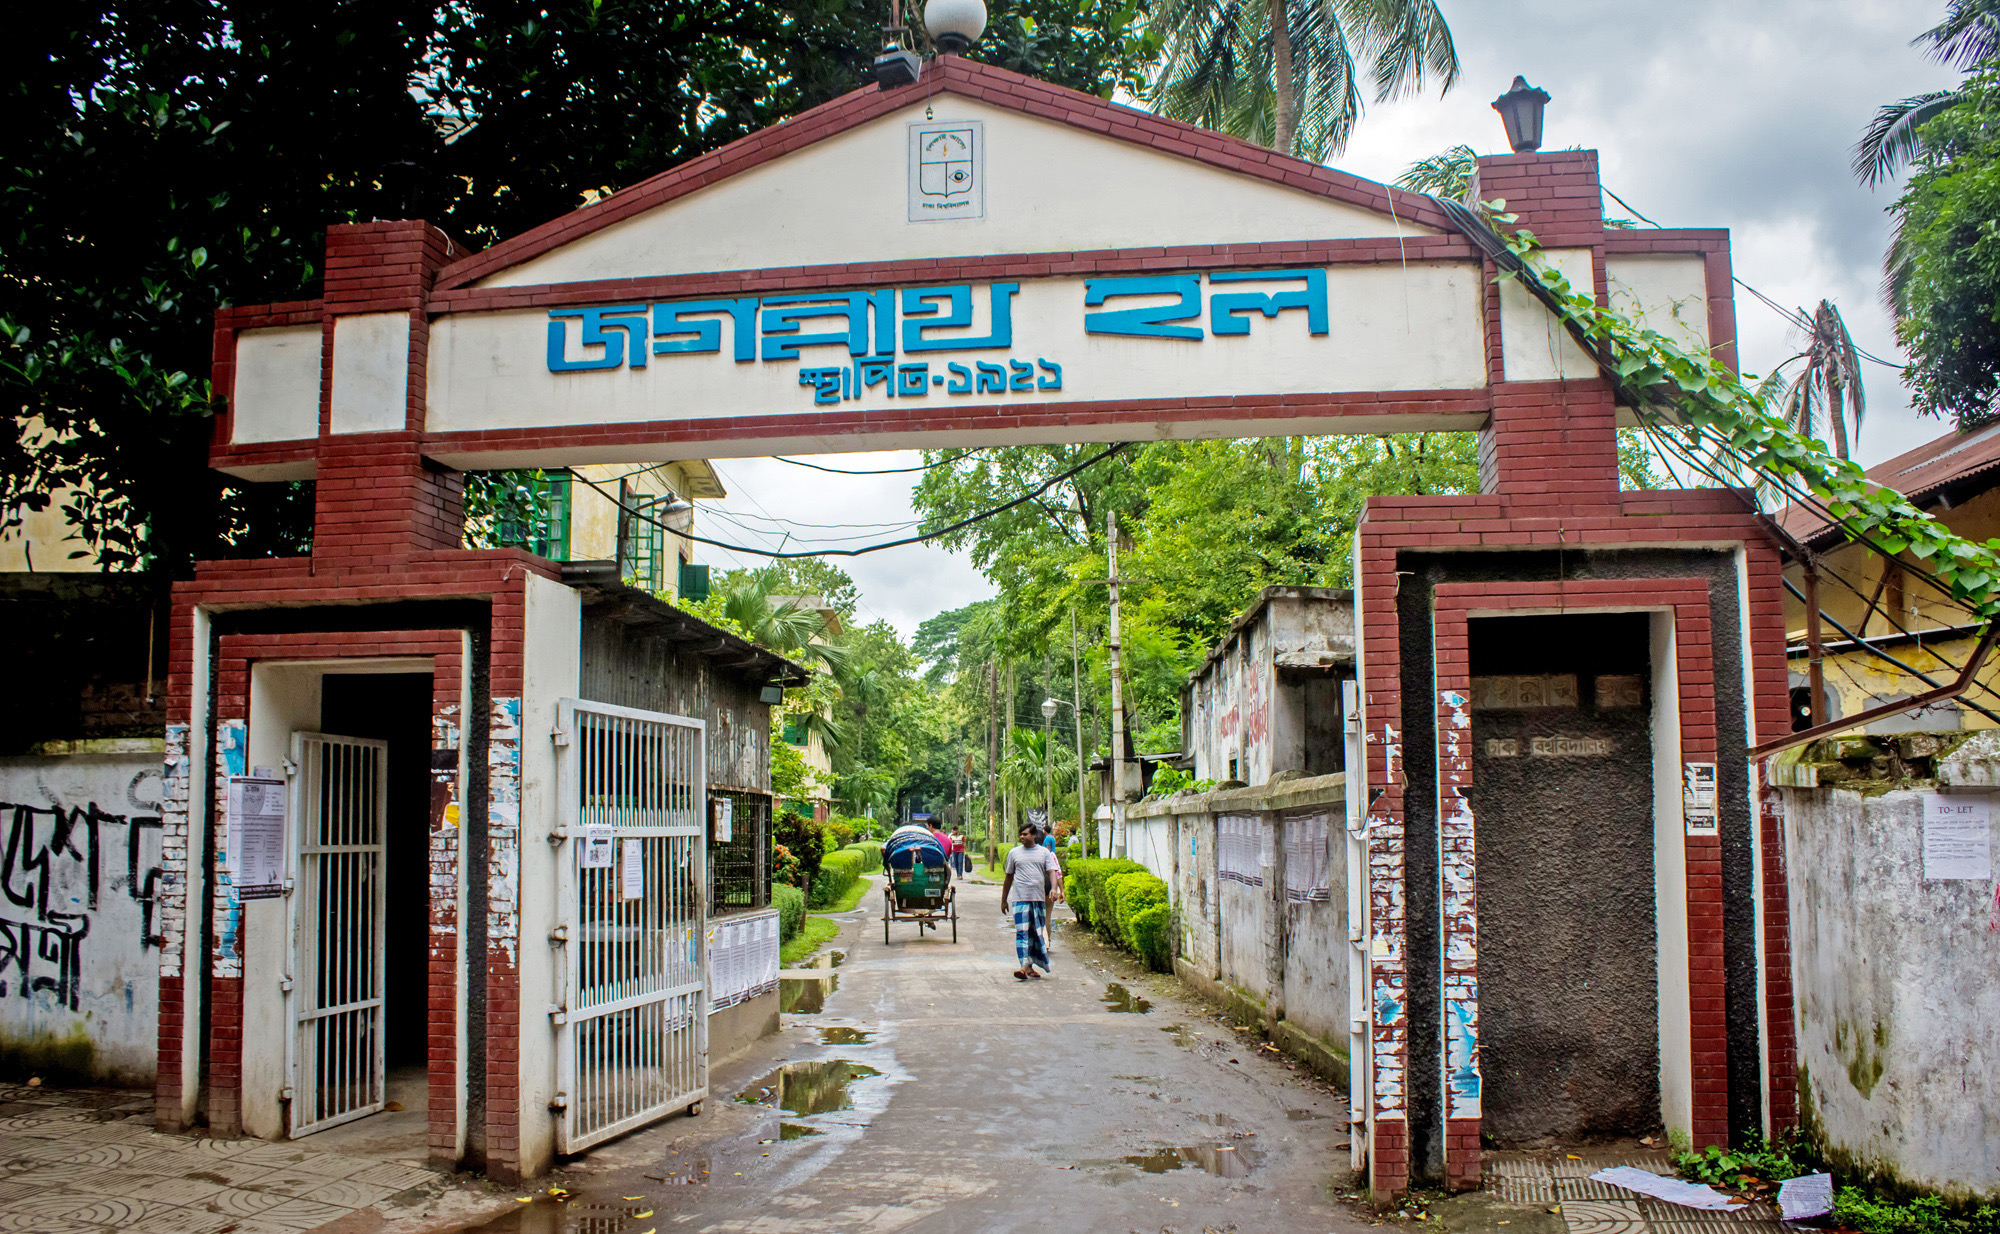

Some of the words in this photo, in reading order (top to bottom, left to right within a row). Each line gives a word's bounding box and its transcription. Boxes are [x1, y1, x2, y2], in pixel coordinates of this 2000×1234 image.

[547, 282, 1020, 373] জগন্নাথ
[1085, 268, 1329, 341] হল
[1957, 806, 1974, 814] LET
